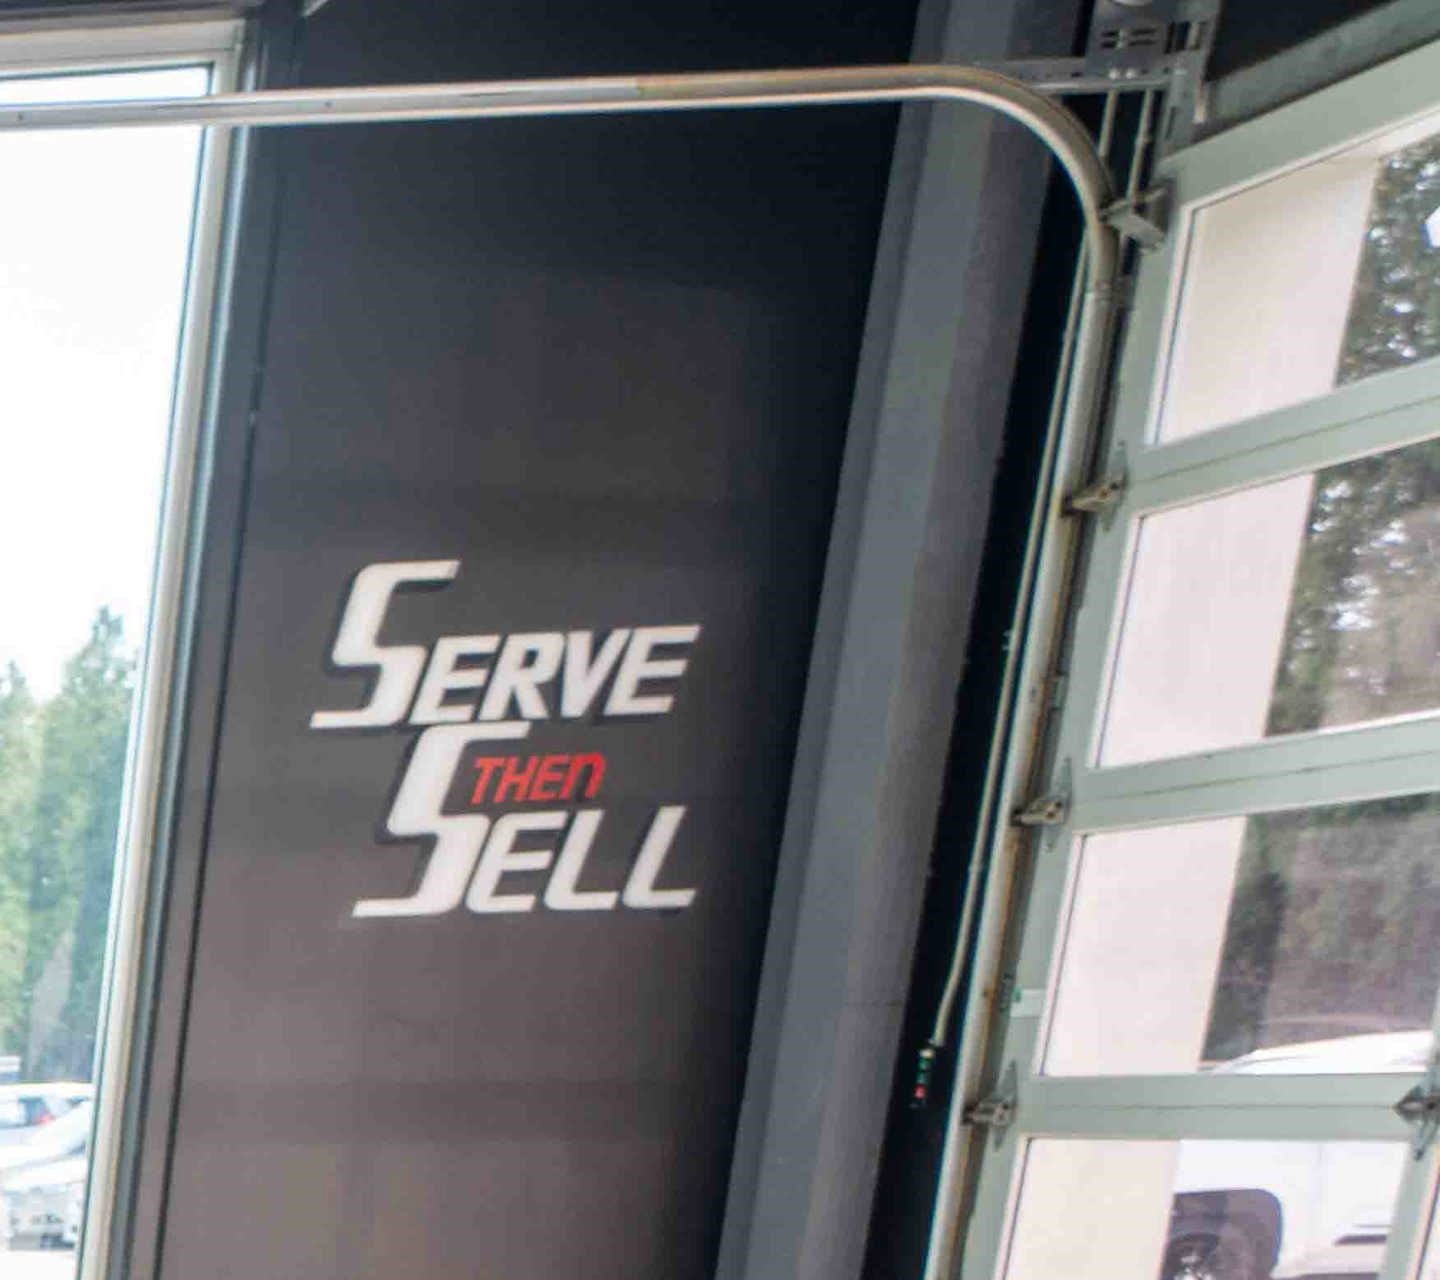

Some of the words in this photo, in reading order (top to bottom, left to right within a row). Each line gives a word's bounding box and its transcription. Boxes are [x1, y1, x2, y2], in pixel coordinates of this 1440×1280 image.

[310, 558, 701, 729] SERVE
[351, 720, 698, 919] SELL
[470, 751, 606, 805] THEN
